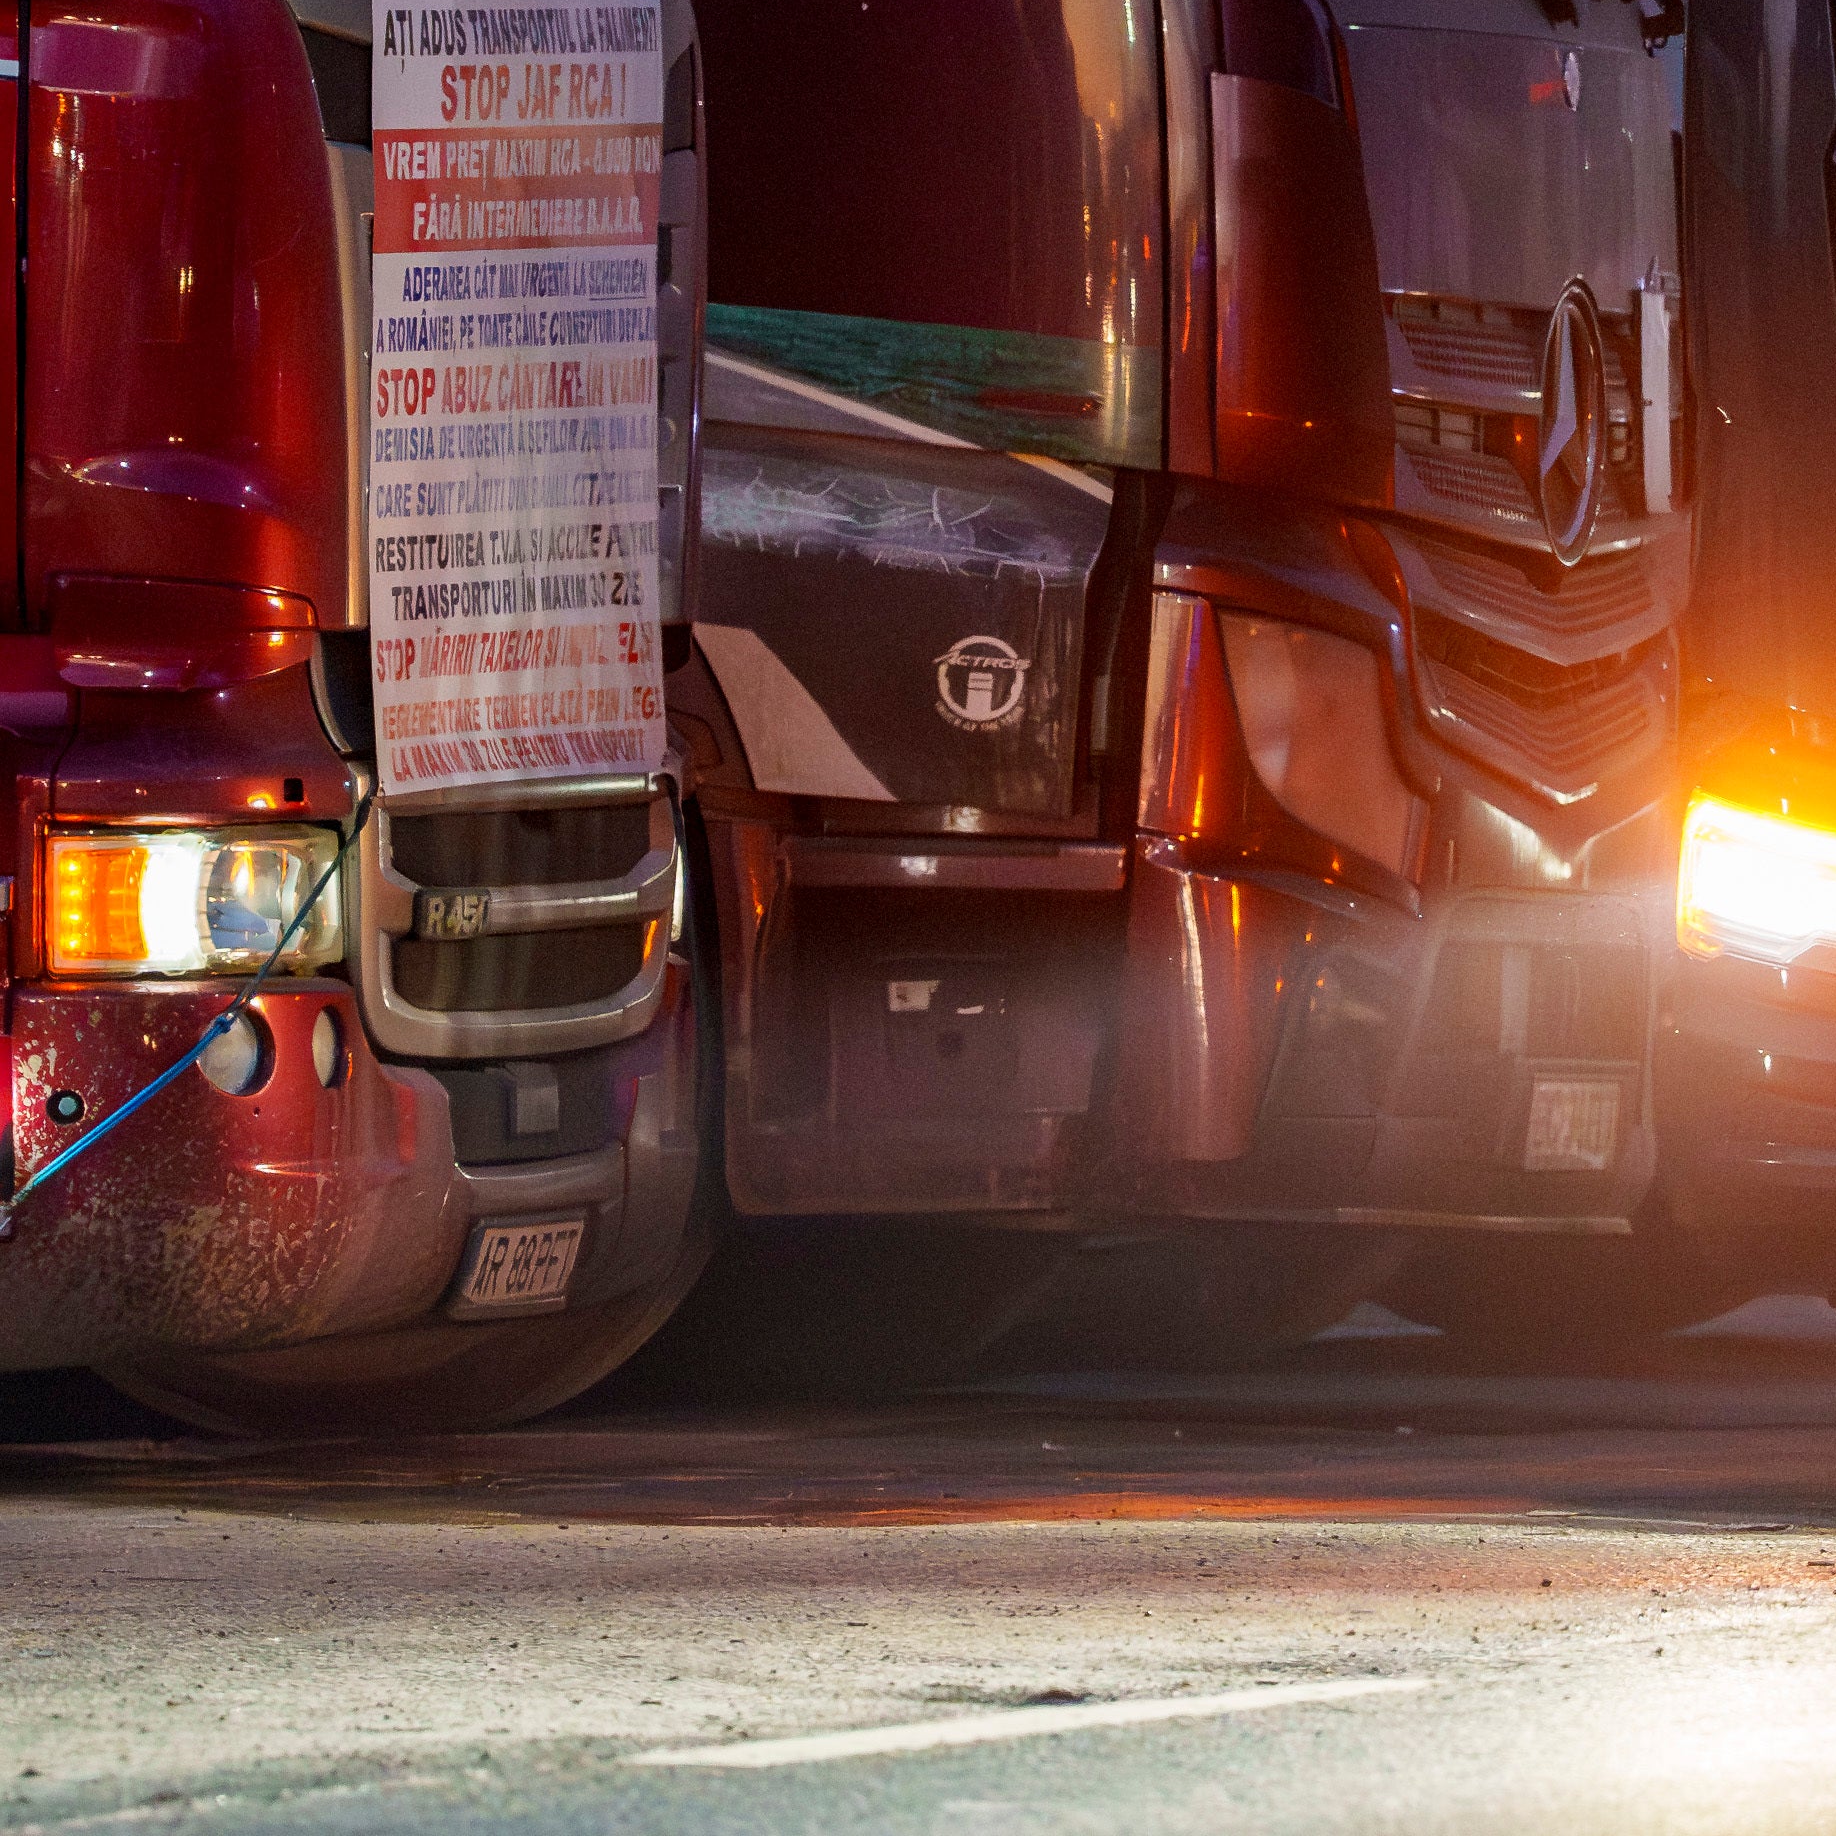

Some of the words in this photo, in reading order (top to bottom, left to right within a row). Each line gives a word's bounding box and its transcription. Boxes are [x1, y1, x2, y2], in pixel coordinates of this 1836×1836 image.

[420, 9, 467, 56] ADUS
[467, 8, 577, 55] TRANSPORTUL
[441, 64, 511, 122] STOP
[517, 64, 562, 120] JAF
[568, 63, 613, 119] RCA
[383, 142, 441, 180] VREM
[402, 264, 472, 302] ADERAREA
[377, 367, 437, 418] STOP
[441, 364, 493, 414] ABUZ
[375, 425, 435, 463] DEMISIA
[439, 423, 455, 459] DE
[376, 482, 412, 519] CARE
[416, 480, 456, 516] SUNT
[376, 530, 486, 573] RESTITUIREA
[391, 578, 518, 621] TRANSPORTURI
[541, 574, 587, 611] MAXIM
[377, 637, 416, 683] STOP
[391, 746, 414, 782] LA
